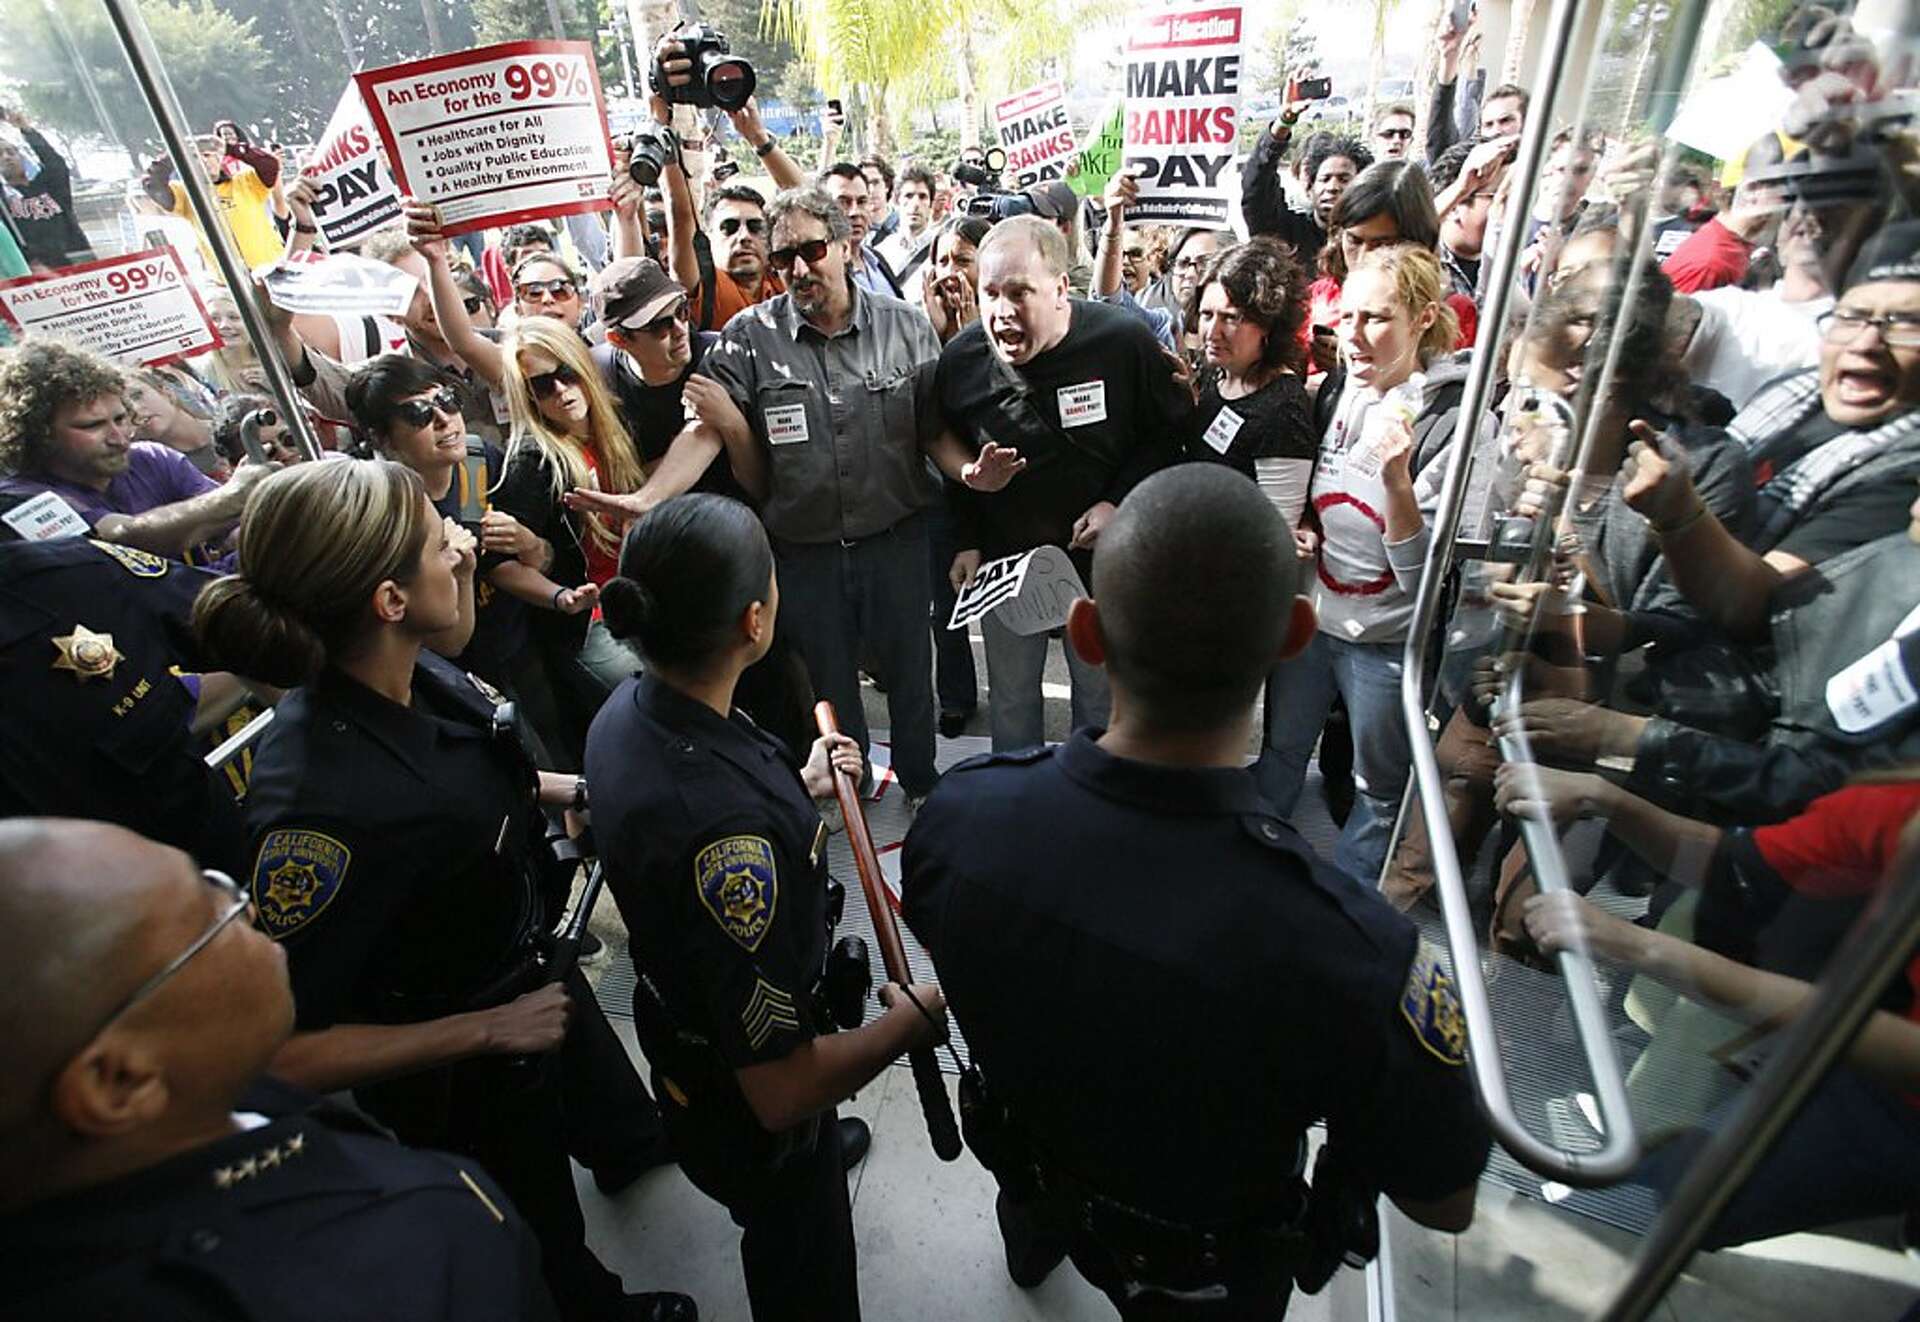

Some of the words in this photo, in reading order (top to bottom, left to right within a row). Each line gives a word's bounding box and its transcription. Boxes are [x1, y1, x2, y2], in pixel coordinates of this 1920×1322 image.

[386, 88, 412, 106] An
[414, 71, 497, 97] Economy
[504, 61, 588, 101] 99%
[1126, 55, 1240, 98] MAKE
[444, 97, 471, 115] for
[473, 90, 502, 109] the
[427, 123, 497, 148] Healthcare
[499, 117, 520, 132] for
[524, 115, 543, 129] All
[1001, 104, 1067, 146] MAKE
[1127, 106, 1235, 145] BANKS
[432, 146, 462, 163] Jobs
[464, 140, 494, 157] with
[496, 131, 546, 152] Dignity
[436, 157, 483, 179] Quality
[485, 148, 528, 168] Public
[530, 144, 593, 161] Education
[1008, 131, 1075, 173] BANKS
[310, 159, 380, 217] PAY
[441, 180, 451, 194] A
[452, 167, 503, 191] Healthy
[507, 160, 589, 181] Environment
[1126, 154, 1232, 188] PAY
[11, 290, 33, 305] An
[33, 276, 100, 299] Economy
[106, 261, 176, 295] 99%
[61, 296, 83, 308] for
[85, 289, 108, 303] the
[703, 840, 766, 868] CALIFORNIA
[261, 903, 306, 925] POLICE
[728, 916, 767, 937] POLICE
